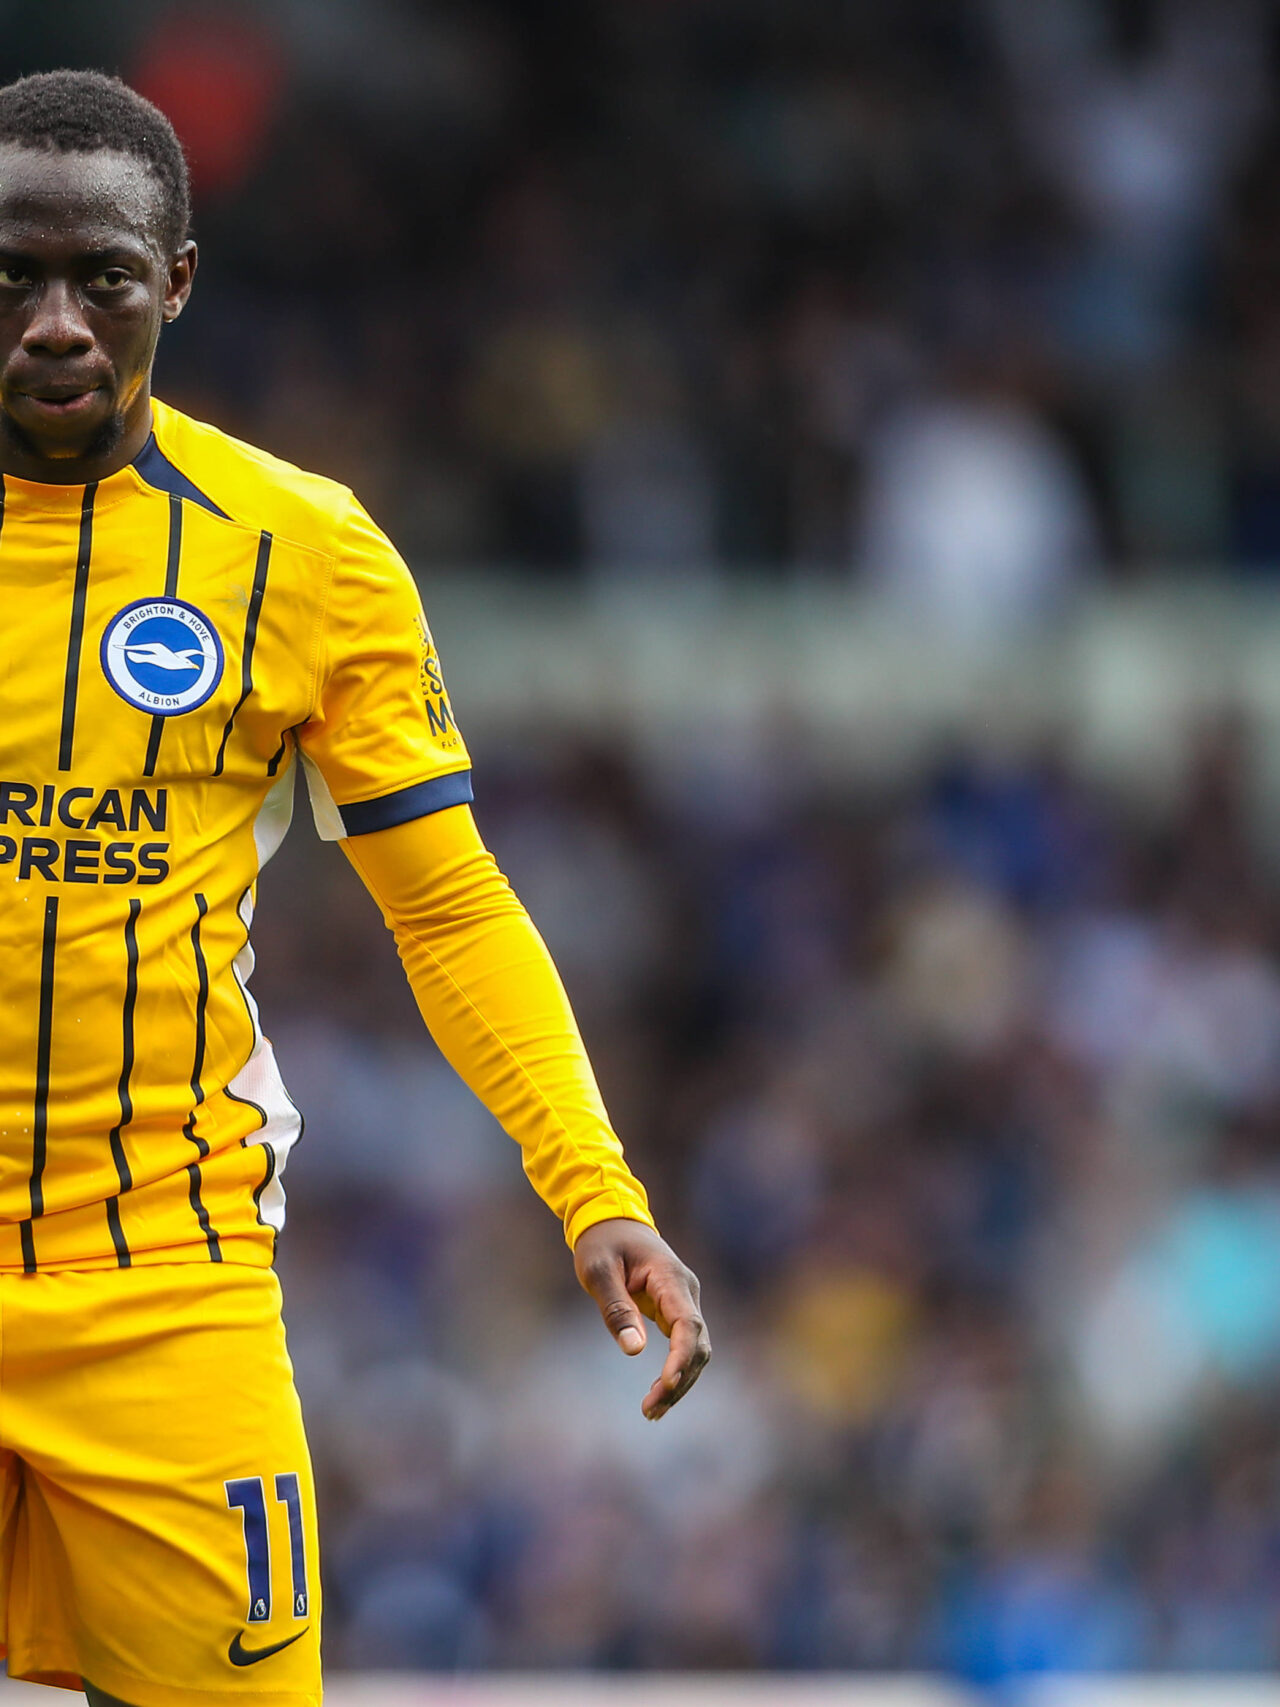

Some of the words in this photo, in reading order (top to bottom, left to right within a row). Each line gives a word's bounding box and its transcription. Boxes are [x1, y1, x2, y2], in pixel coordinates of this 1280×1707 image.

[123, 606, 174, 629] BRIGHTON
[178, 611, 186, 620] &
[189, 617, 210, 642] HOVE
[139, 691, 180, 706] ALBION
[441, 737, 460, 750] FLO
[224, 1472, 309, 1623] 11
